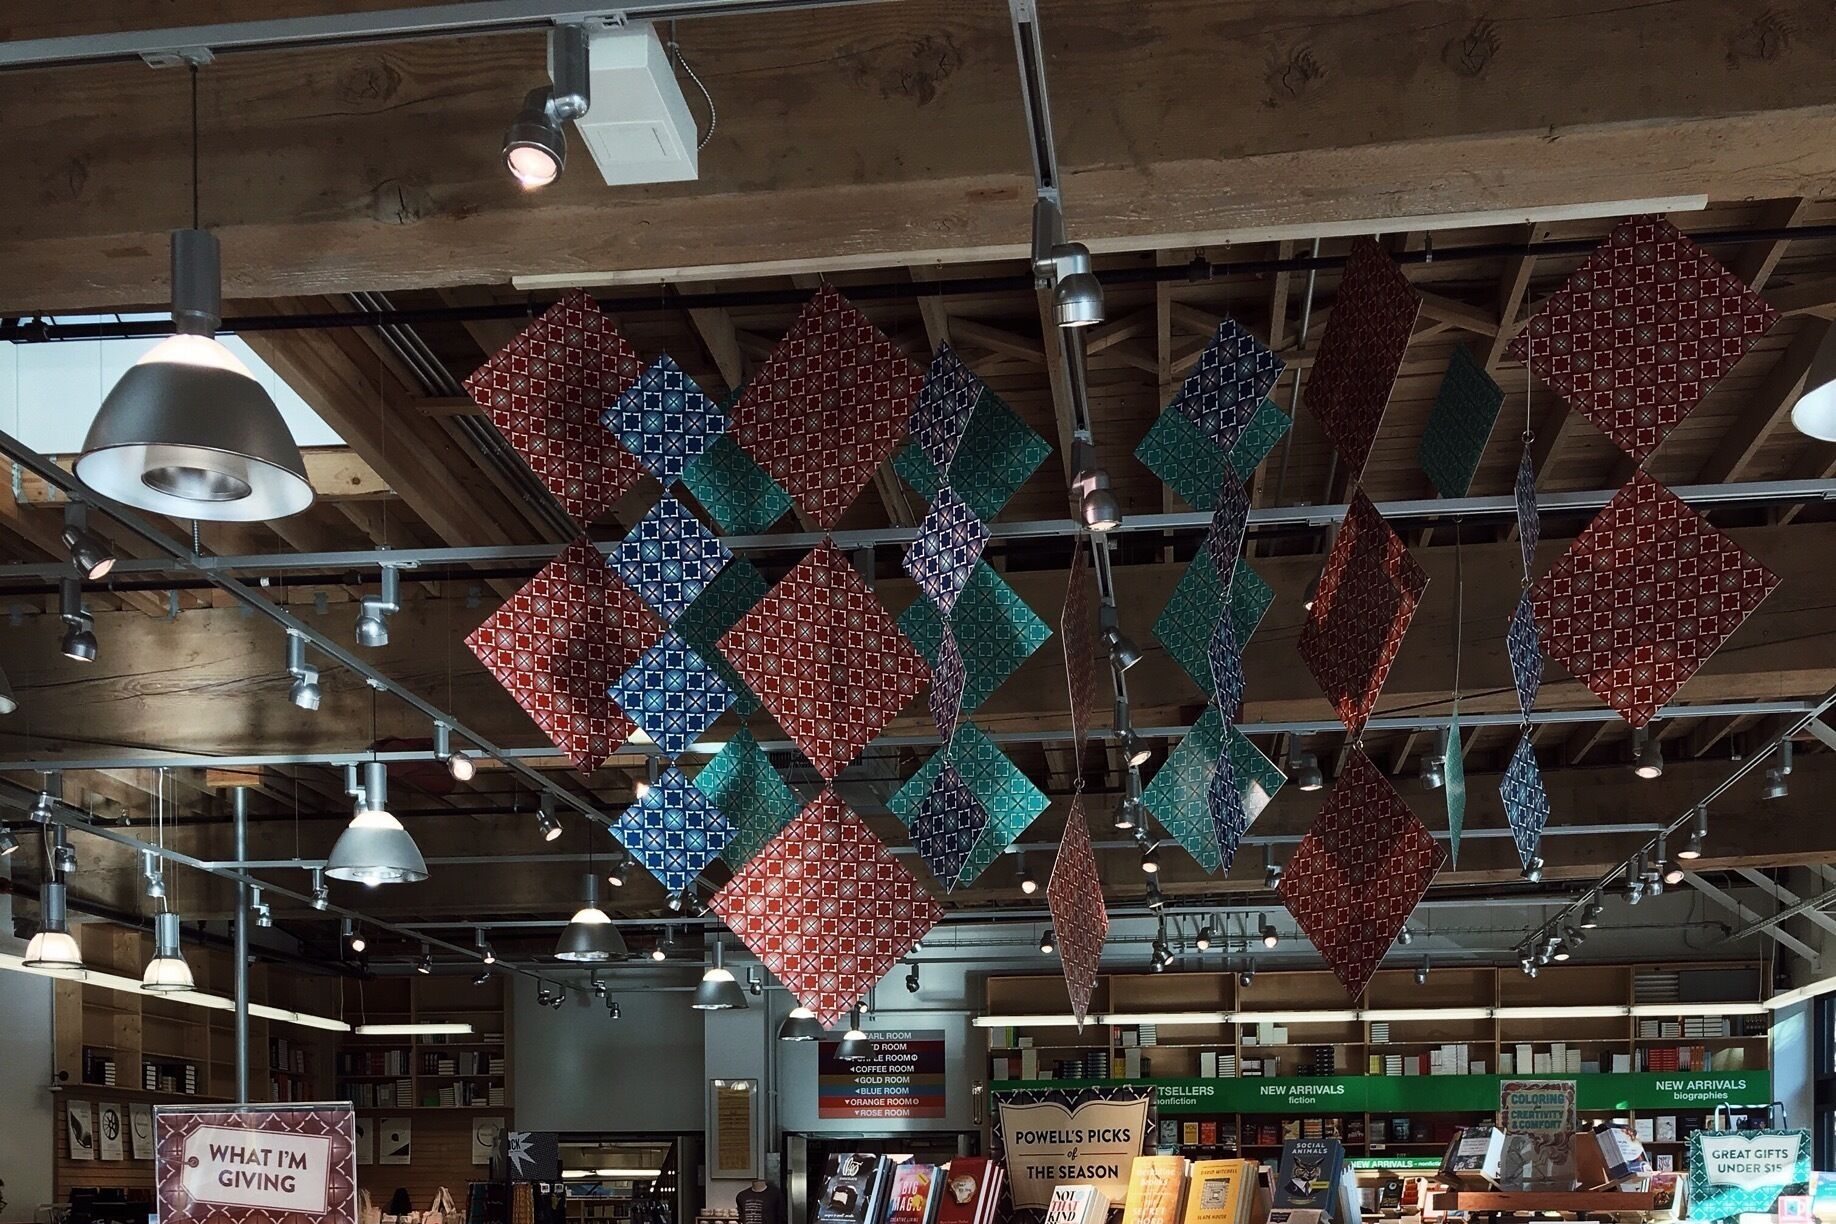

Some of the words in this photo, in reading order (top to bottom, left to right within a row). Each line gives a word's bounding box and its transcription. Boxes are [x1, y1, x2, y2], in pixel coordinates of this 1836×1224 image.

[865, 1032, 886, 1040] EARL
[881, 1043, 907, 1051] ROOM
[1260, 1086, 1286, 1095] NEW
[1289, 1085, 1345, 1095] ARRIVALS
[1656, 1080, 1685, 1091] NEW
[1687, 1079, 1746, 1090] ARRIVALS
[1157, 1086, 1215, 1096] TSELLERS
[1673, 1091, 1728, 1101] biographies
[1288, 1096, 1316, 1105] fiction
[1511, 1093, 1565, 1105] COLORING
[1518, 1120, 1562, 1130] COMFORT
[1016, 1130, 1083, 1144] POWELL'S
[1088, 1128, 1131, 1143] PICKS
[209, 1144, 272, 1167] WHAT
[277, 1149, 308, 1171] I'M
[1067, 1147, 1078, 1160] of
[1712, 1150, 1751, 1159] GREAT
[1754, 1149, 1788, 1159] GIFTS
[1372, 1160, 1413, 1168] ARRIVALS
[1718, 1164, 1761, 1173] UNDER
[1764, 1163, 1782, 1173] $15
[1027, 1166, 1054, 1179] THE
[1058, 1165, 1118, 1178] SEASON
[218, 1169, 296, 1194] GIVING
[902, 1181, 918, 1194] BIG
[1055, 1191, 1075, 1201] NOT
[1051, 1200, 1078, 1211] THAT
[1048, 1211, 1075, 1222] KIND
